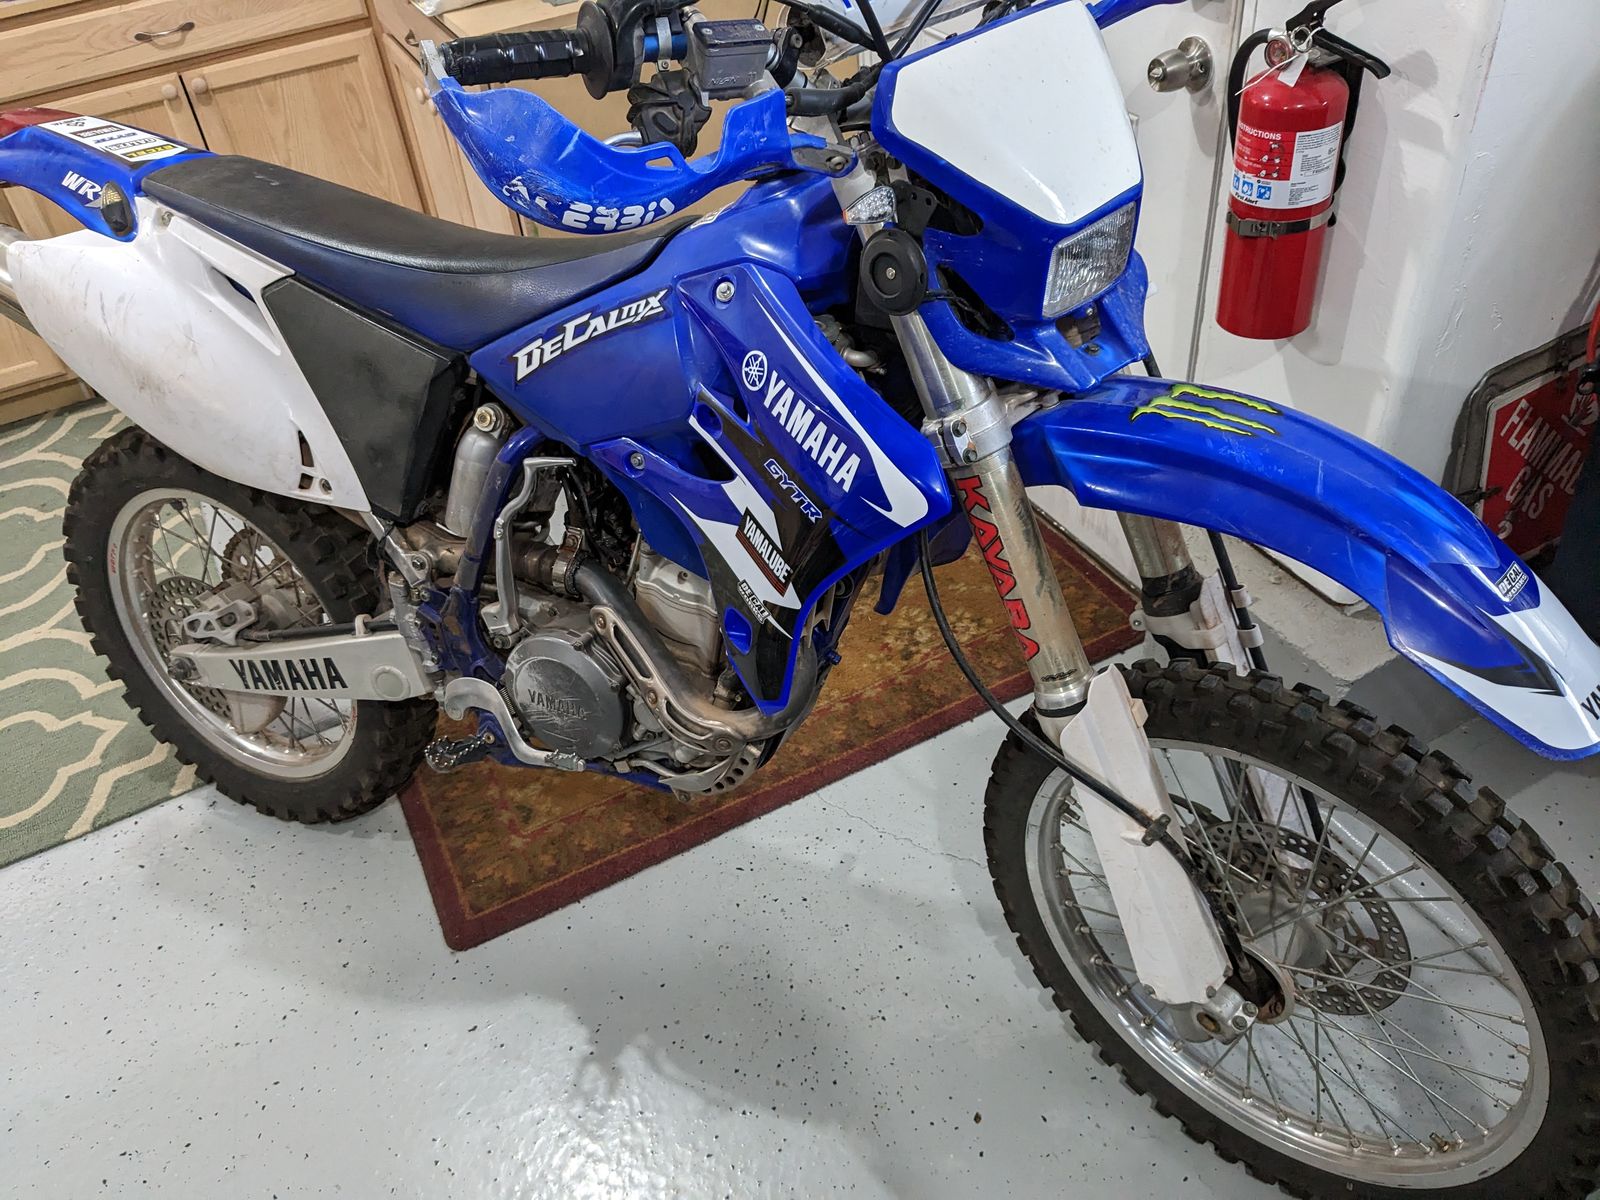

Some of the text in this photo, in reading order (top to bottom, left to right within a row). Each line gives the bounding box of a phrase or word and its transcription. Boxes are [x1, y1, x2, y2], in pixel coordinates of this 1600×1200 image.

[1238, 123, 1282, 141] STRUCTIONS
[763, 370, 861, 493] YAMAHA
[764, 458, 823, 524] GYTR
[1505, 465, 1555, 520] GAS
[743, 515, 790, 584] YAMALUBE
[740, 580, 770, 619] DECAL
[229, 657, 348, 691] YAMAHA
